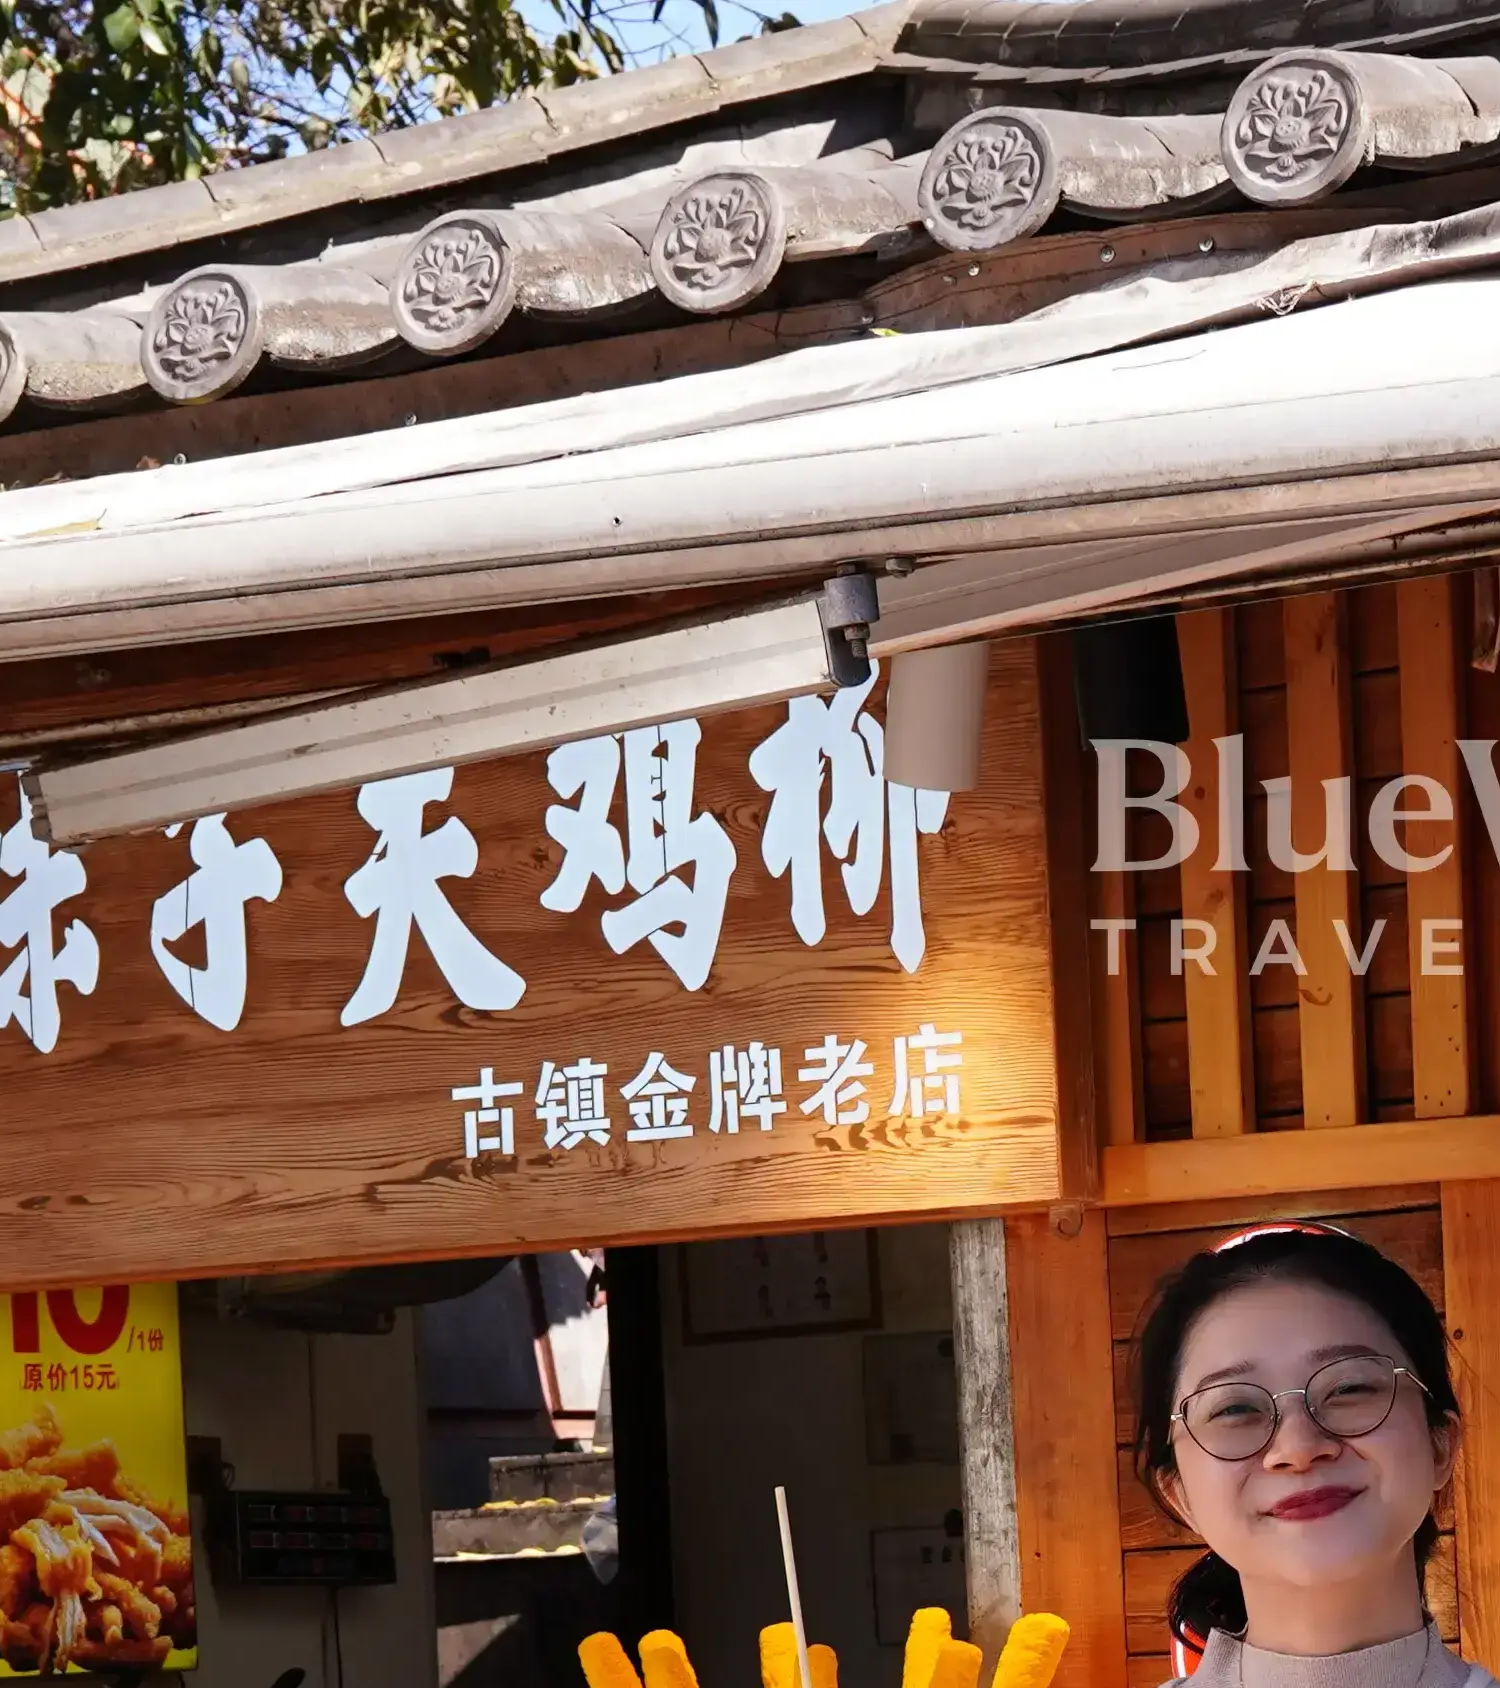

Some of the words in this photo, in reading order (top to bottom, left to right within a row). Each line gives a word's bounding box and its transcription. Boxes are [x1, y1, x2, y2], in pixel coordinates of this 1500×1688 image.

[452, 1023, 963, 1159] 古镇金牌老店
